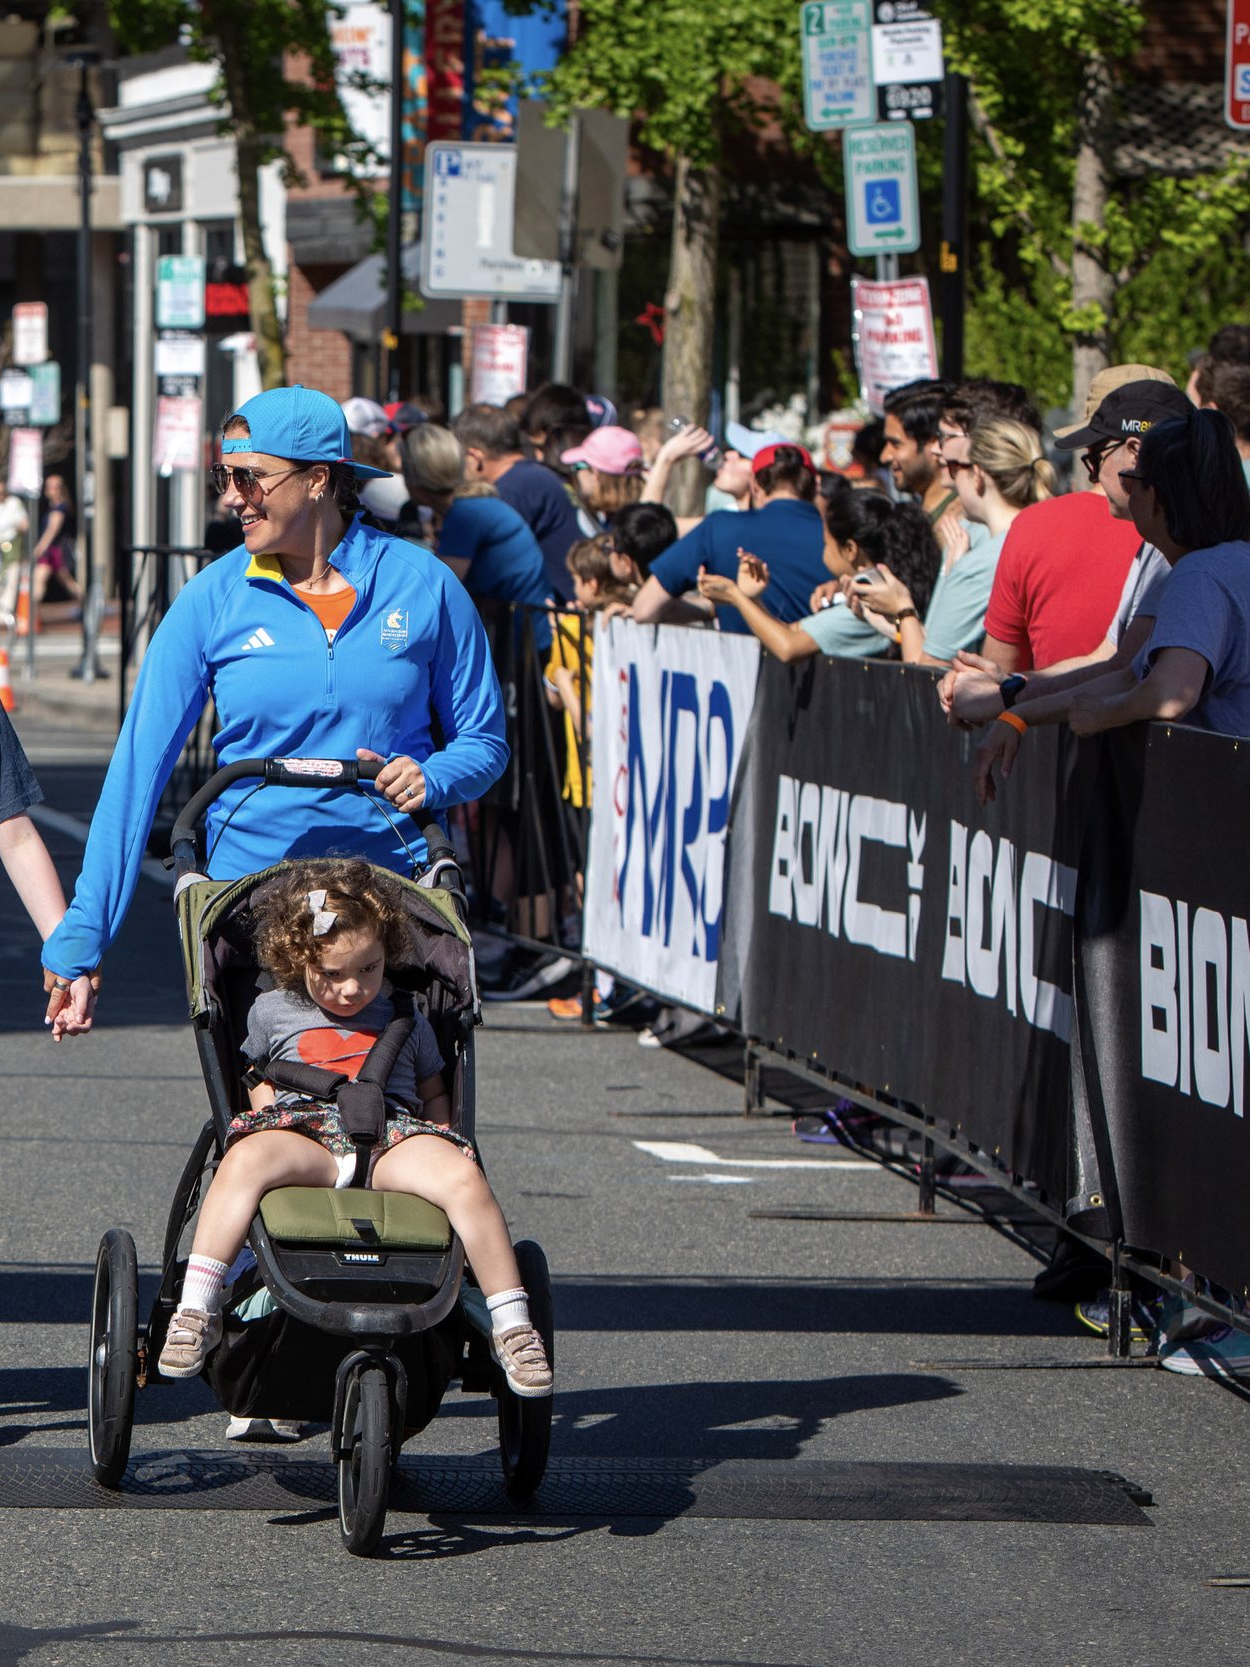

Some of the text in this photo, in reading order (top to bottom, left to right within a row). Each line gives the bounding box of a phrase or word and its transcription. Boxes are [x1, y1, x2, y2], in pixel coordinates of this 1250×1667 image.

[807, 6, 821, 33] 2
[1234, 22, 1250, 46] P
[856, 157, 905, 175] PARKING
[343, 1253, 380, 1262] THULE
